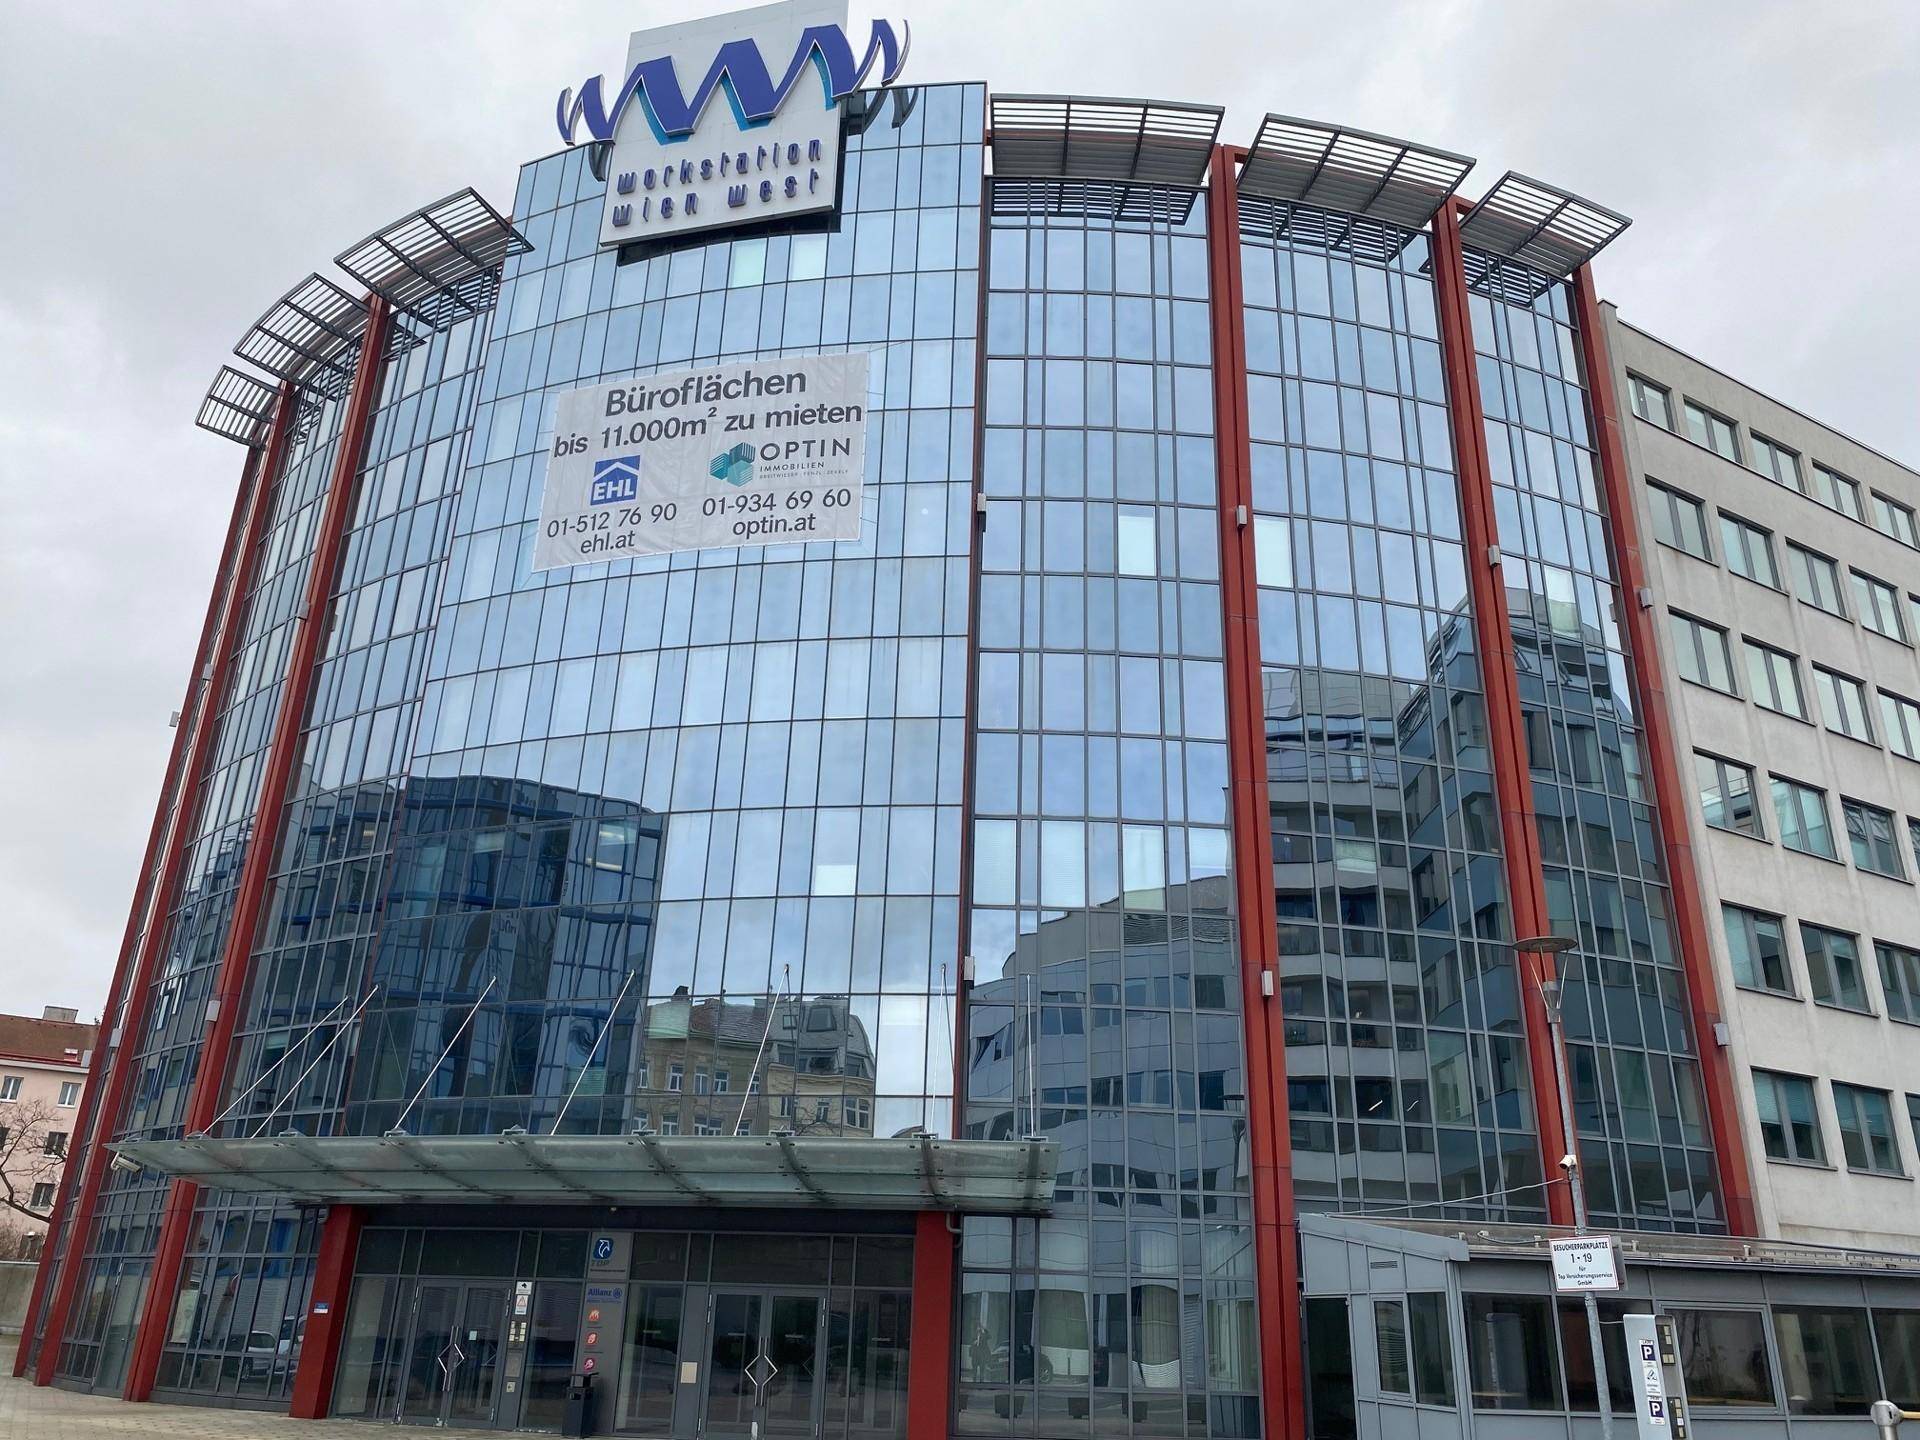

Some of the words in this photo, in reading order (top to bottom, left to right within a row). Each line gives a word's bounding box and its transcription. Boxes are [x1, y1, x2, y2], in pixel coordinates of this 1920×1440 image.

[617, 139, 821, 195] workstation
[612, 193, 699, 228] wien
[728, 168, 820, 208] west
[606, 370, 807, 417] Büroflächen
[554, 433, 588, 458] bis
[724, 413, 755, 432] zu
[765, 403, 862, 428] mieten
[760, 438, 850, 461] OPTIN
[760, 462, 824, 472] IMMOBILIEN
[593, 478, 635, 501] EHL
[702, 492, 776, 516] 01-934
[786, 490, 813, 509] 69
[823, 488, 851, 507] 60
[547, 511, 610, 538] 01-512
[618, 507, 642, 527] 76
[651, 503, 677, 523] 90
[732, 513, 816, 539] optin.at
[580, 530, 636, 554] ehl.at
[1582, 1252, 1593, 1263] 19
